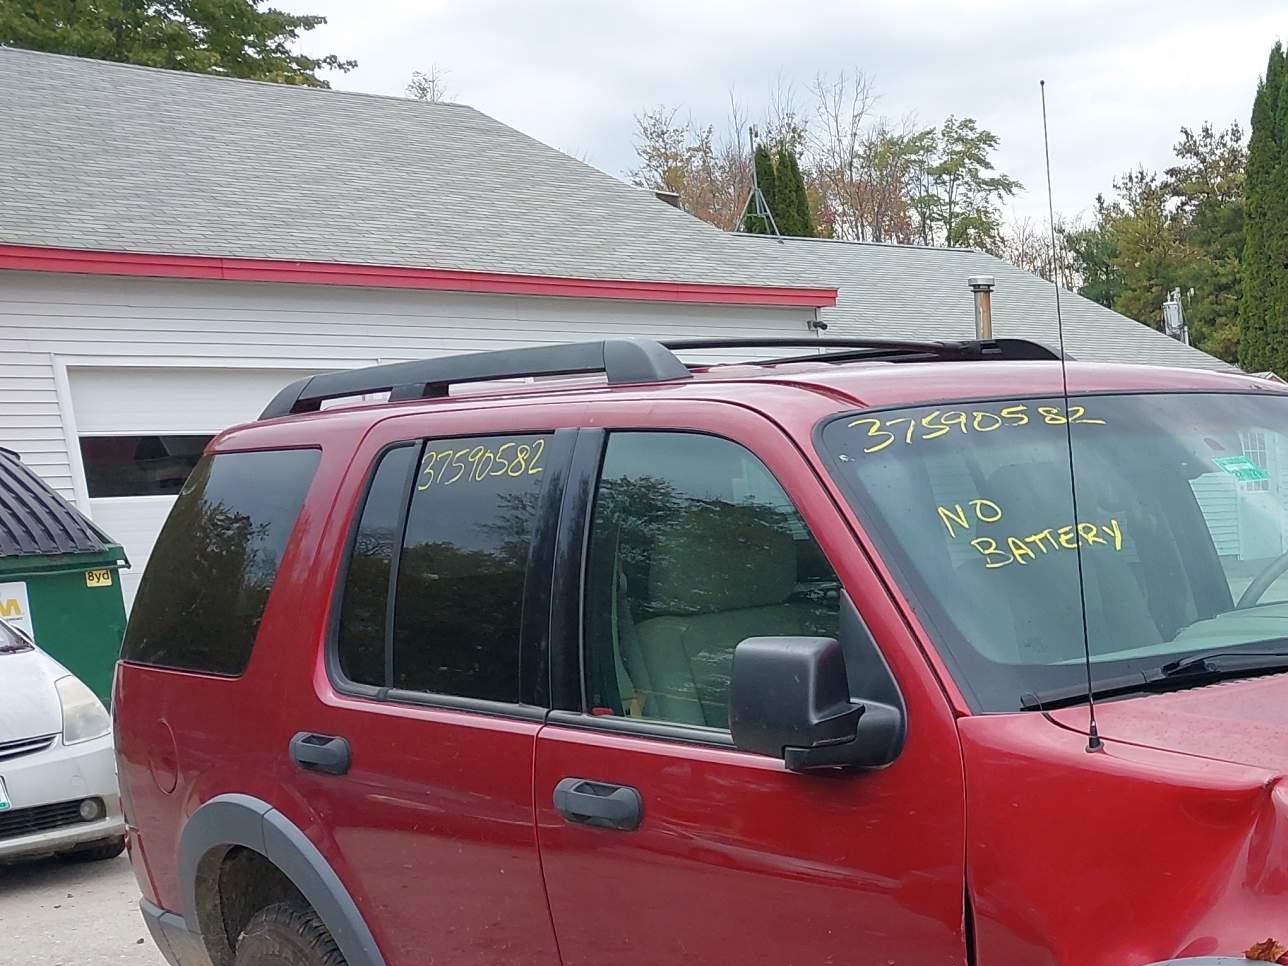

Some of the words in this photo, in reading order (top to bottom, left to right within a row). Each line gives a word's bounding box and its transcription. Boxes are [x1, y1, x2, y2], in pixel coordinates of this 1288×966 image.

[847, 404, 1107, 453] 37590582
[417, 439, 545, 491] 37590582
[937, 499, 1002, 538] NO
[970, 519, 1122, 568] BATTERY
[87, 570, 110, 583] 8yd
